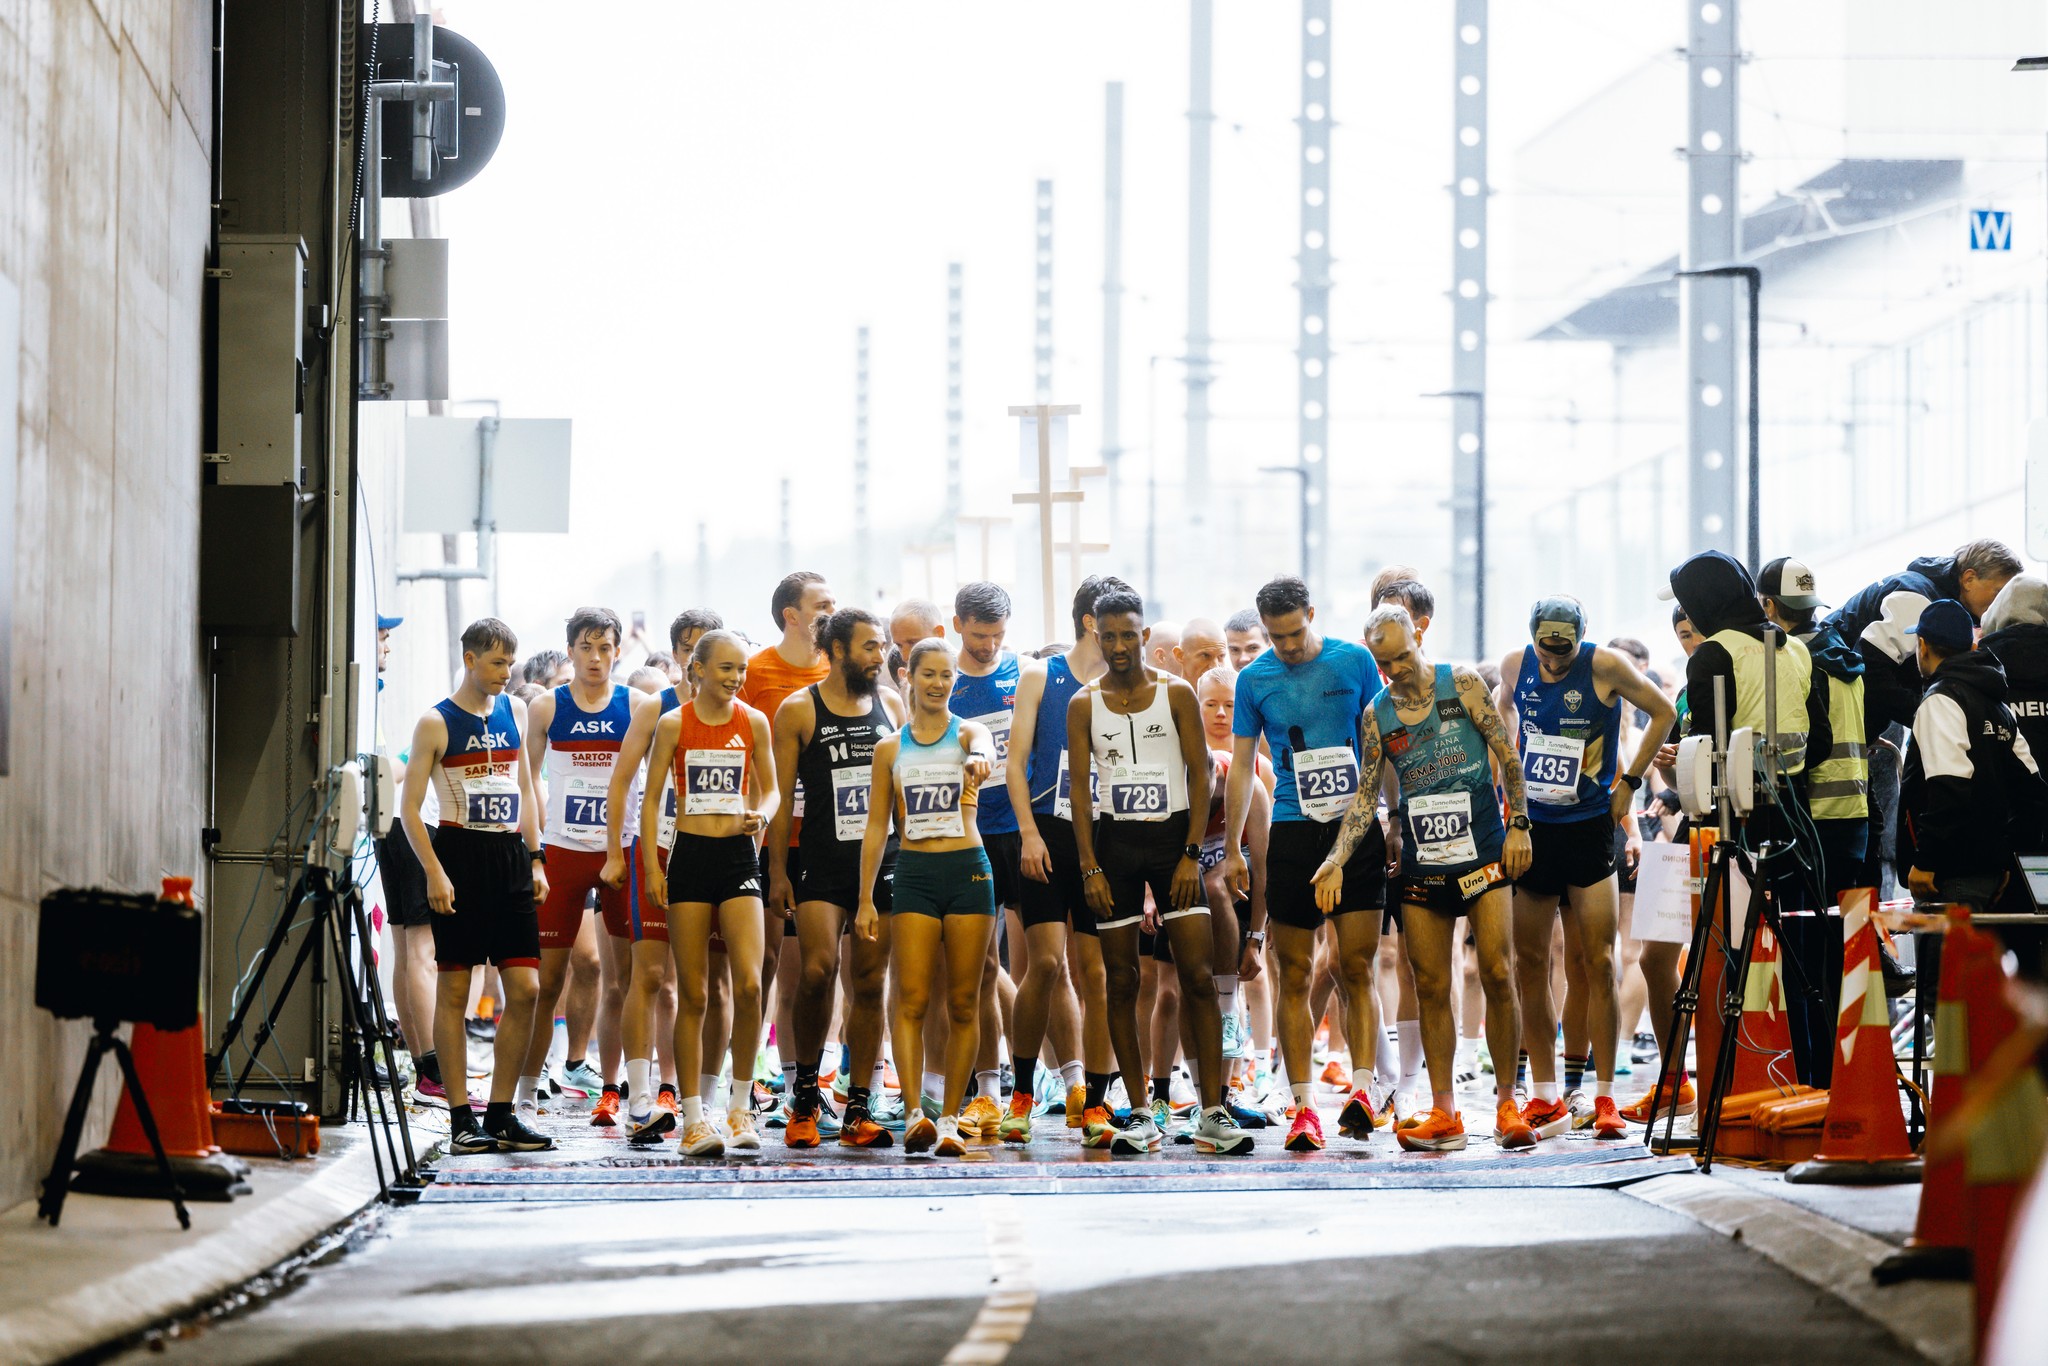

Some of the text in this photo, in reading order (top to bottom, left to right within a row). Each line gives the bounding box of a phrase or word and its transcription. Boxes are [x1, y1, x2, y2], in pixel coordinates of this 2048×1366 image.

[1972, 212, 2010, 249] W
[2010, 701, 2048, 717] NEI
[570, 720, 615, 734] ASK
[465, 731, 510, 751] ASK
[1433, 745, 1465, 759] OPTIKK
[1434, 736, 1460, 749] FANA
[572, 753, 613, 761] SARTOR
[851, 750, 874, 758] Spareb
[1438, 752, 1467, 768] 1000
[464, 763, 511, 776] SARTOR
[696, 768, 735, 791] 406
[1531, 756, 1570, 783] 435
[1307, 768, 1350, 796] 235
[477, 796, 512, 820] 153
[845, 787, 869, 812] 41
[911, 785, 953, 811] 770
[1119, 786, 1160, 810] 728
[1421, 814, 1461, 840] 280
[1463, 863, 1502, 889] Uno X
